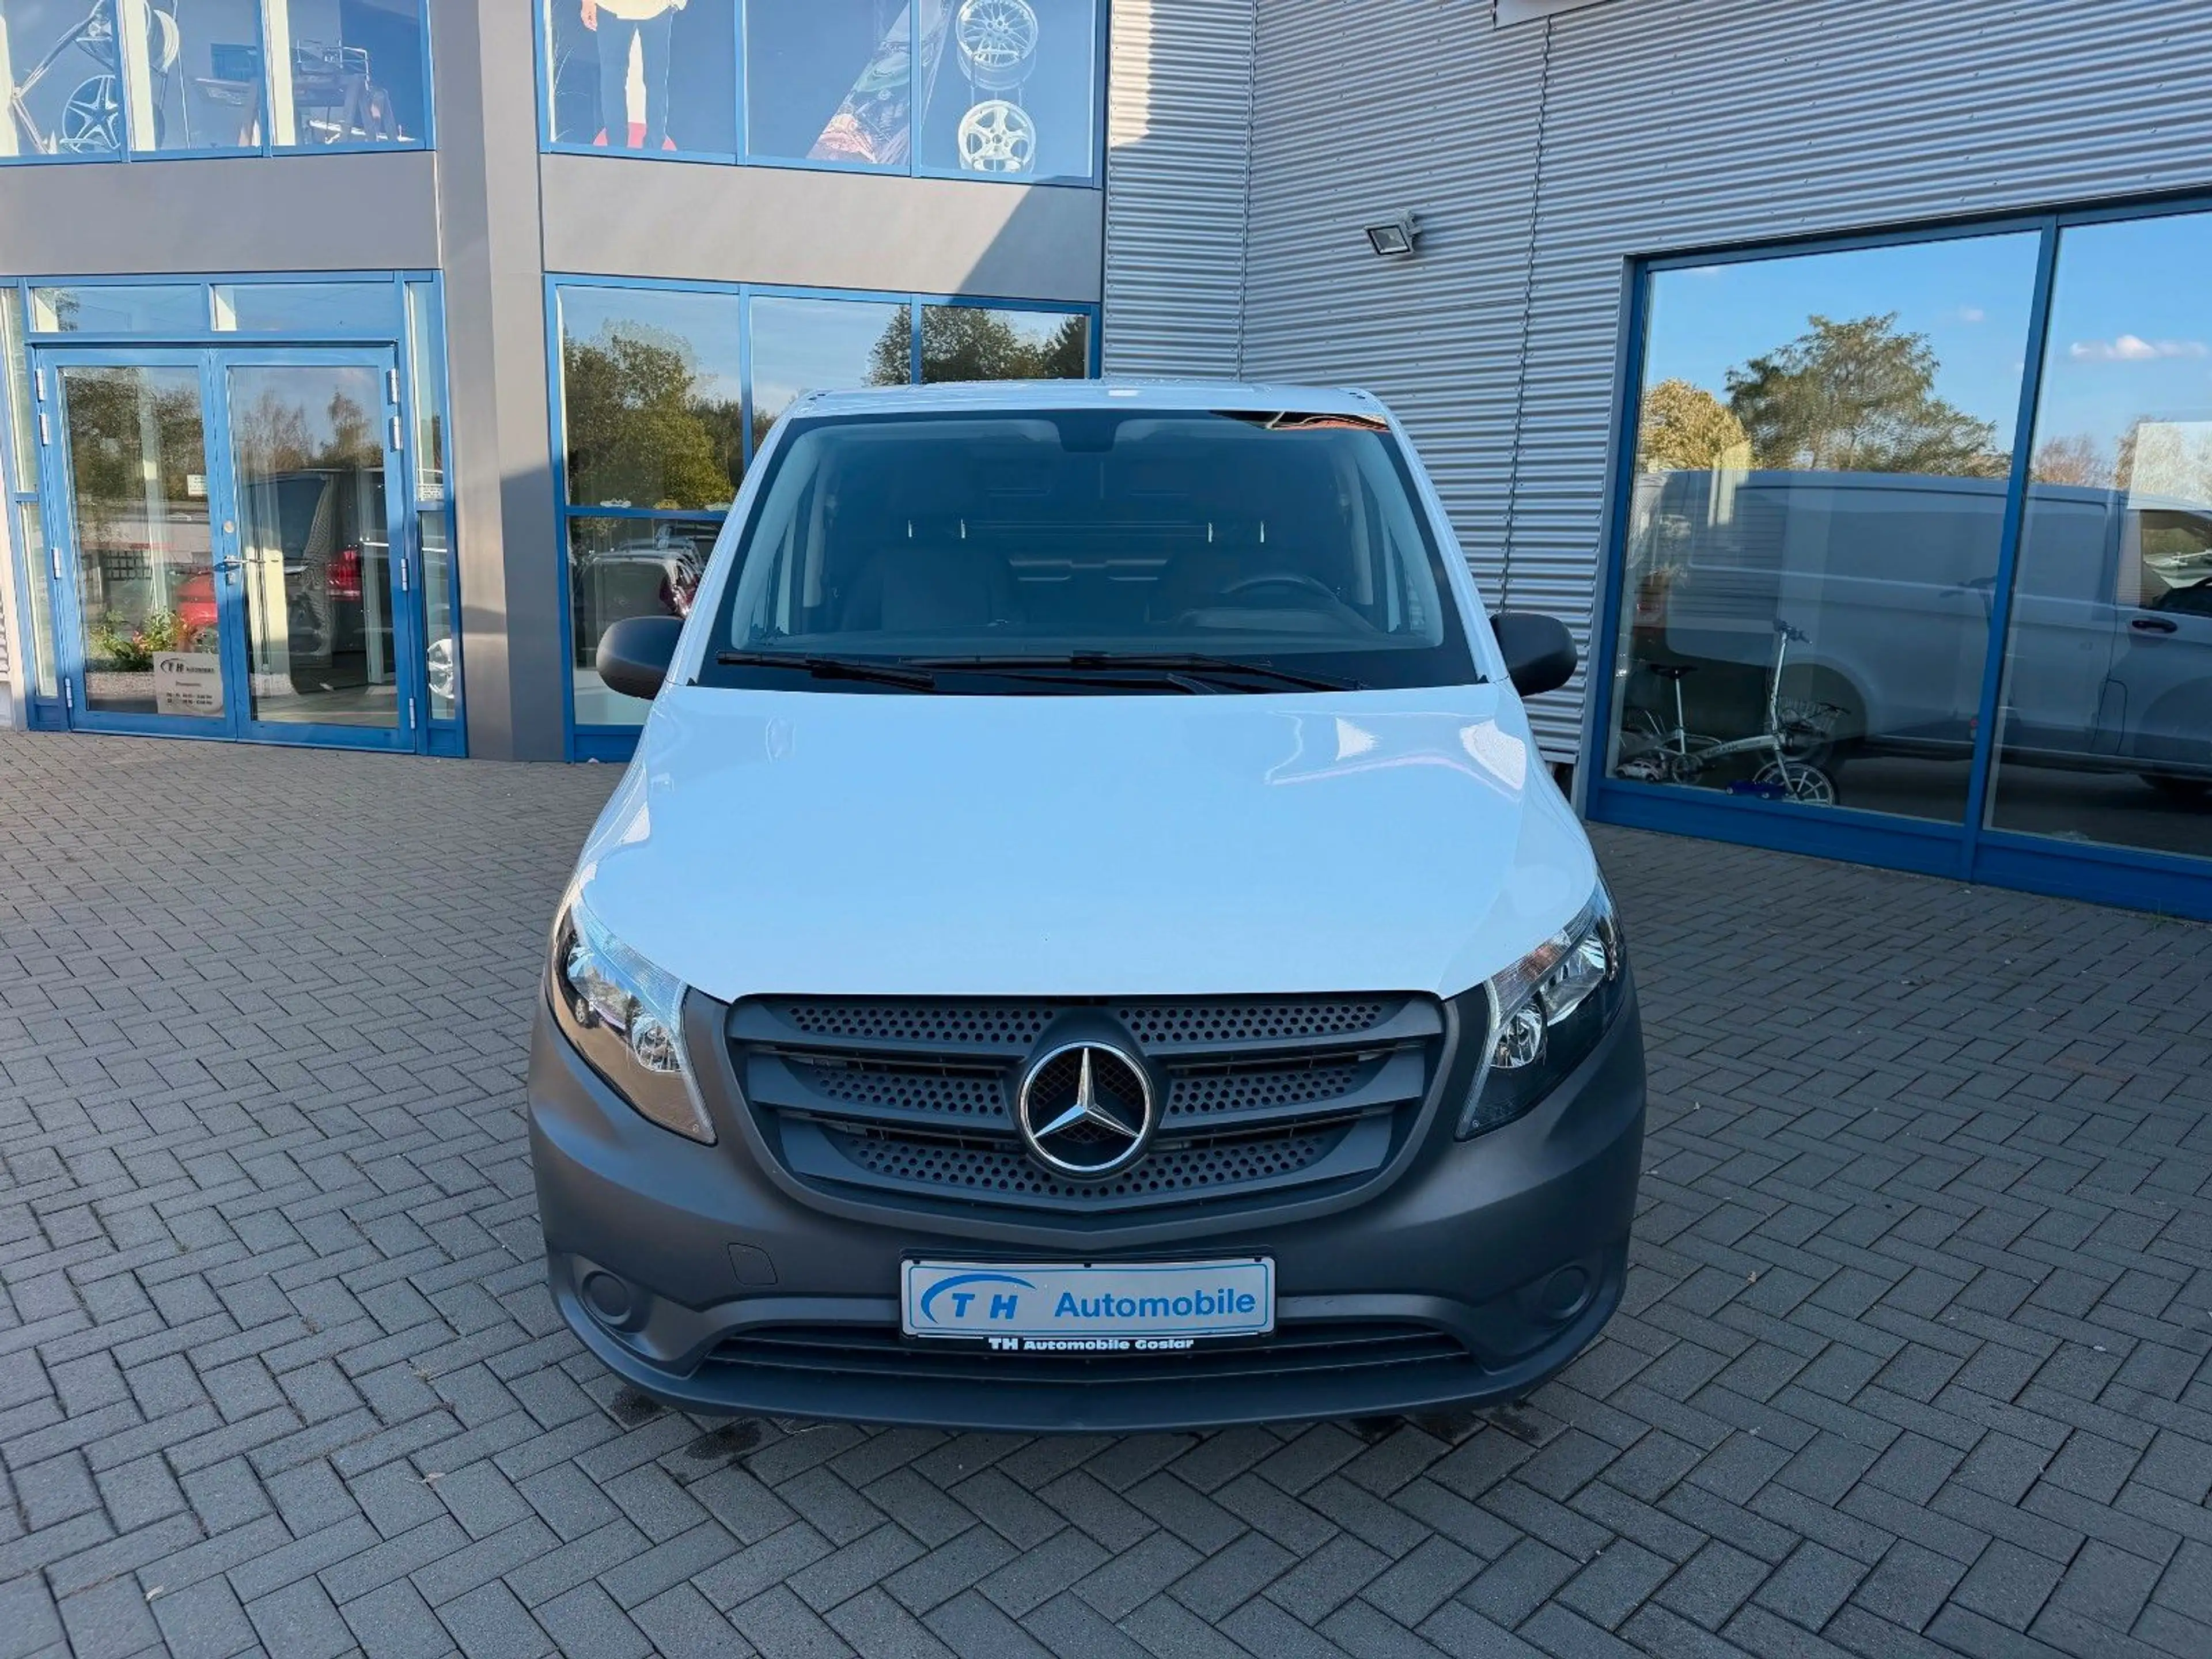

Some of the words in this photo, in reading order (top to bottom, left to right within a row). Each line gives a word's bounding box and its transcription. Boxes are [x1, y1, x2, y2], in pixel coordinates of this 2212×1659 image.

[1055, 1289, 1256, 1317] Automobile
[988, 1338, 1018, 1350] TH
[1023, 1339, 1130, 1350] Automobile
[1135, 1339, 1194, 1350] Goslar
